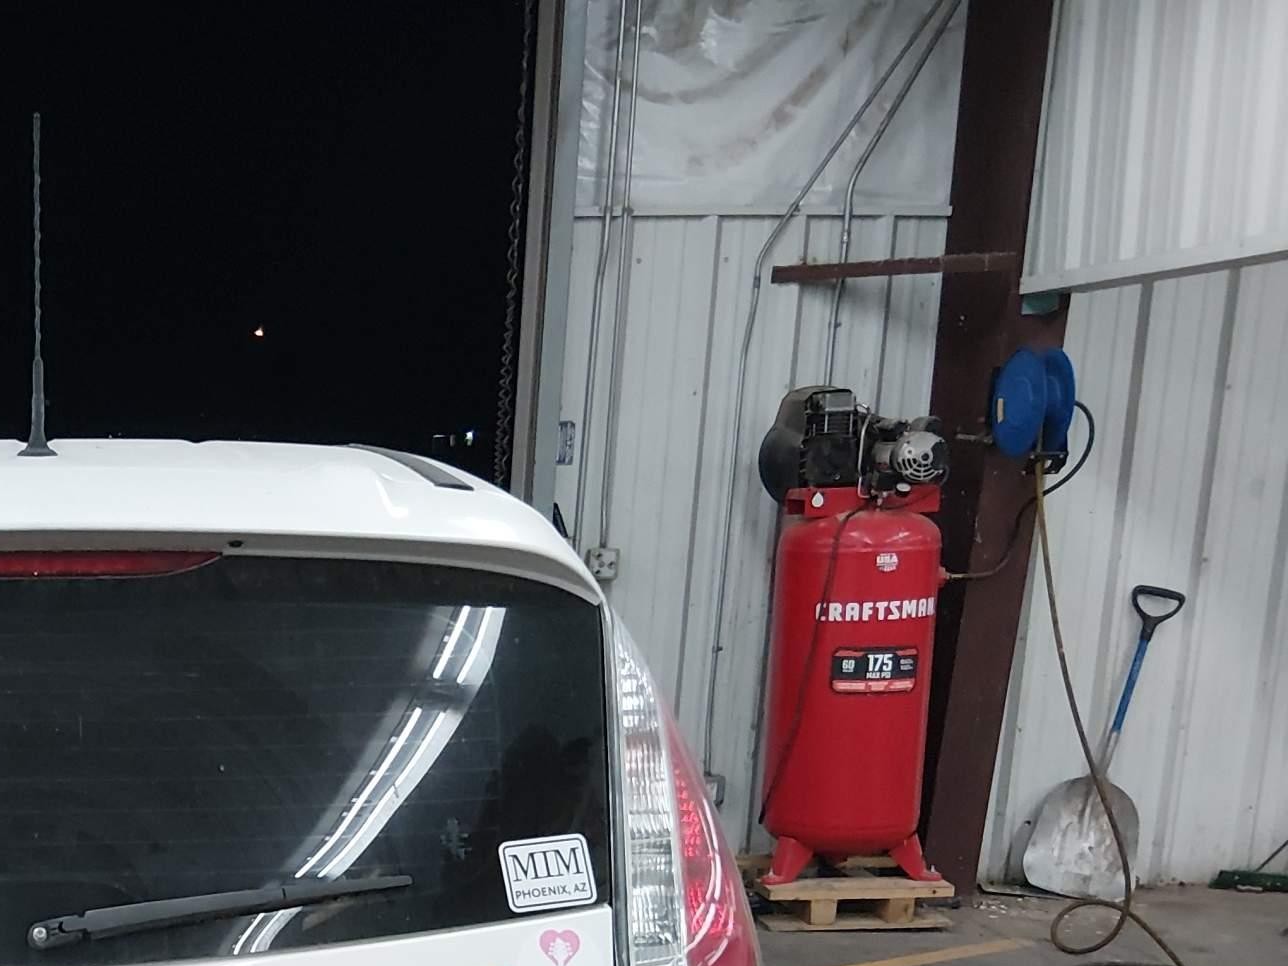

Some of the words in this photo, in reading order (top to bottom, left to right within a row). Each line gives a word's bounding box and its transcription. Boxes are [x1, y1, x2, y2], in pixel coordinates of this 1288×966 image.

[842, 659, 855, 669] 60
[867, 653, 894, 672] 175
[508, 847, 584, 882] MIM
[515, 885, 572, 900] PHOENIX,
[573, 882, 588, 893] AZ
